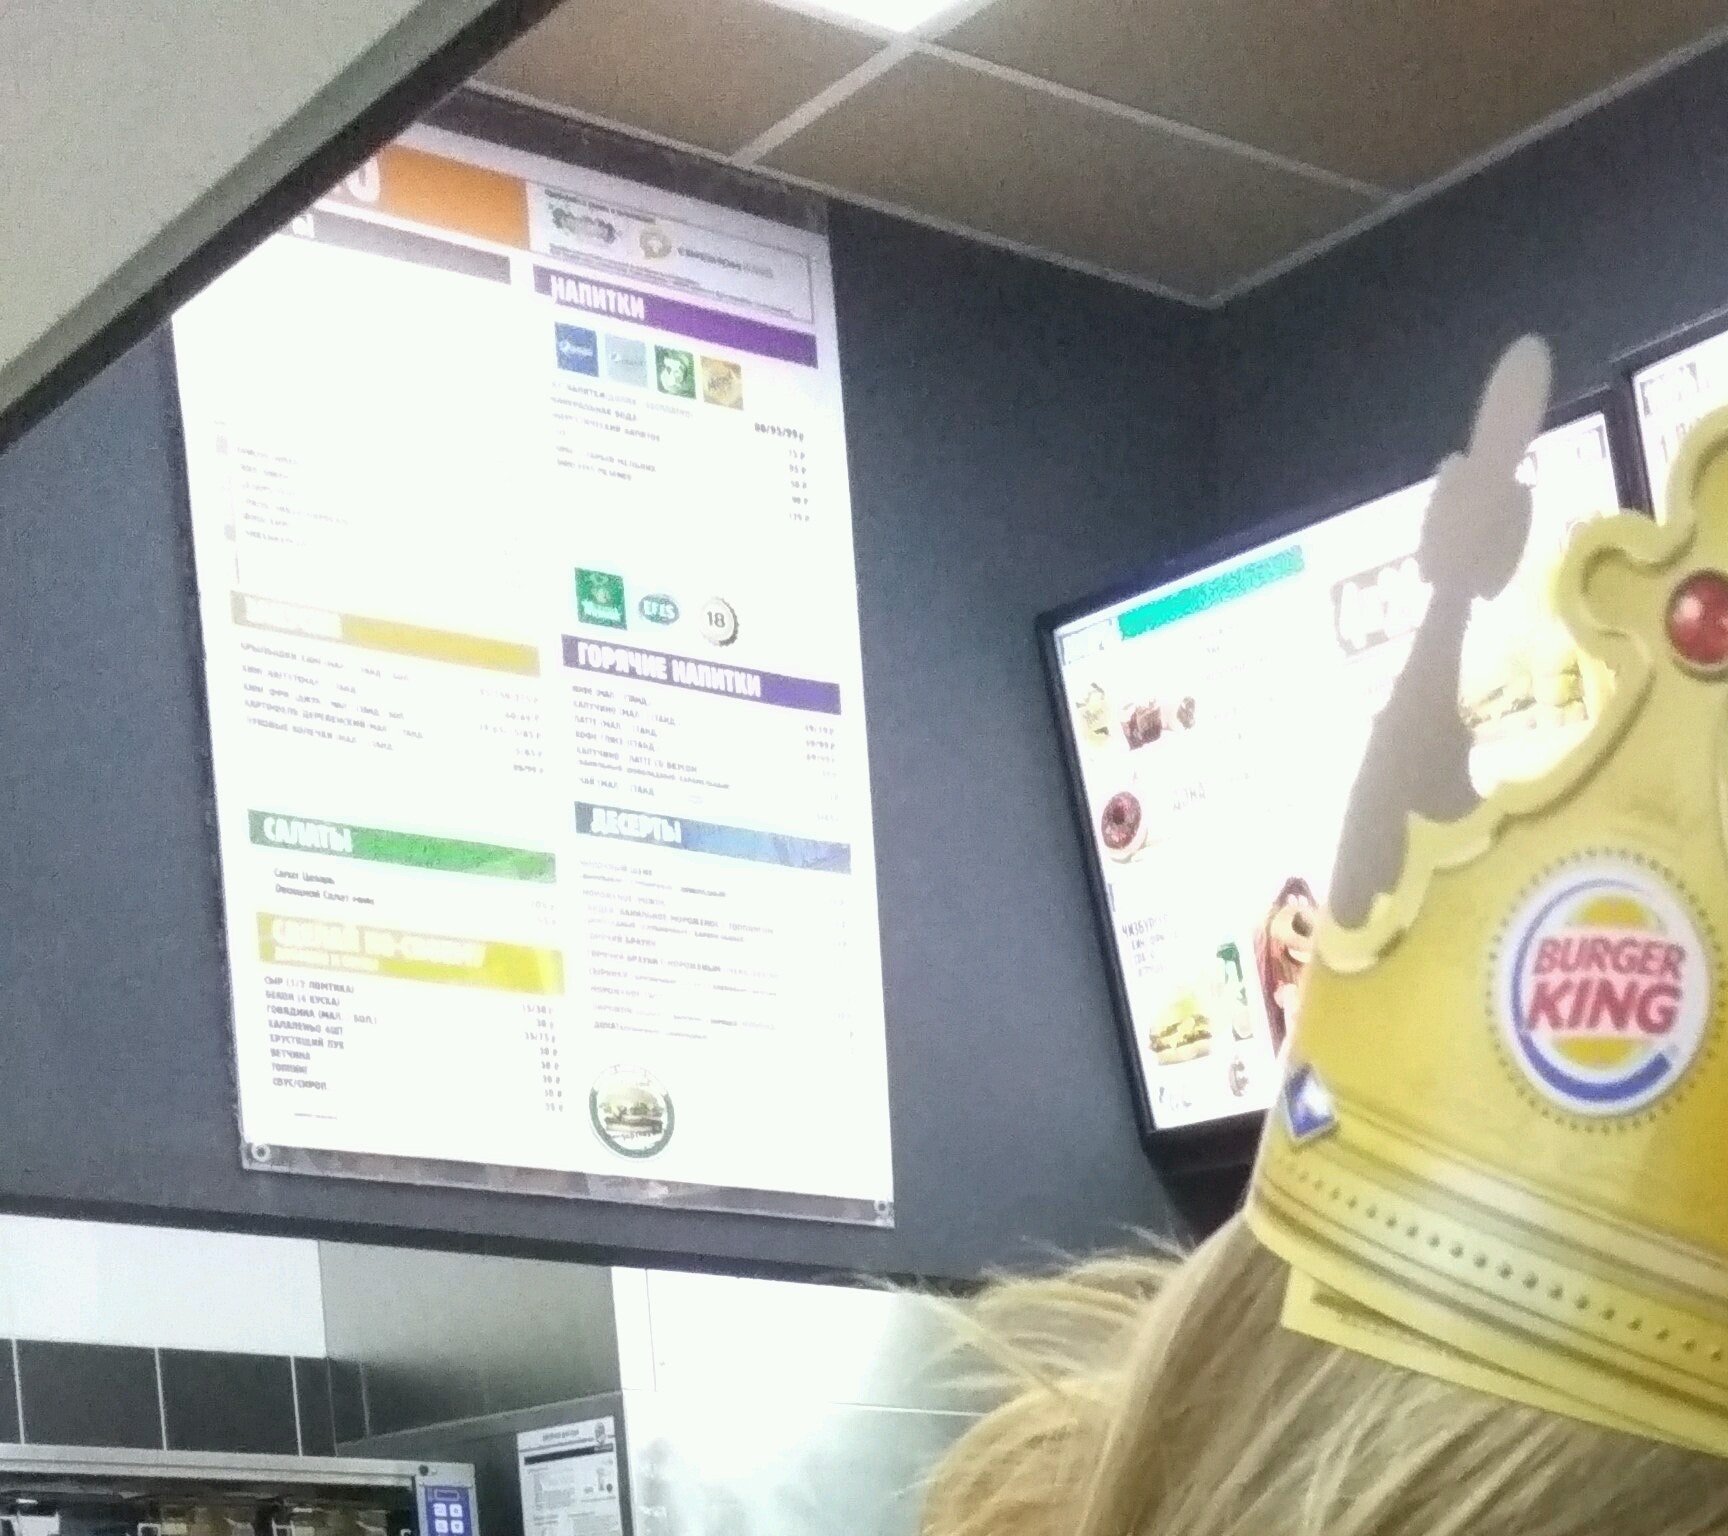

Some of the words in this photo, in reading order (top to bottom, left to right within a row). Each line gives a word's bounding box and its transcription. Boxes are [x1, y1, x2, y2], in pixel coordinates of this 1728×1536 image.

[550, 274, 646, 322] НАПИТКИ
[577, 641, 668, 681] ГОРЯЧИЕ
[671, 659, 762, 698] НАПИТКИ
[263, 817, 353, 853] САЛАТЫ
[590, 807, 682, 843] ДЕСЕРТЫ
[1534, 936, 1688, 979] BURGER
[1525, 974, 1682, 1035] KING
